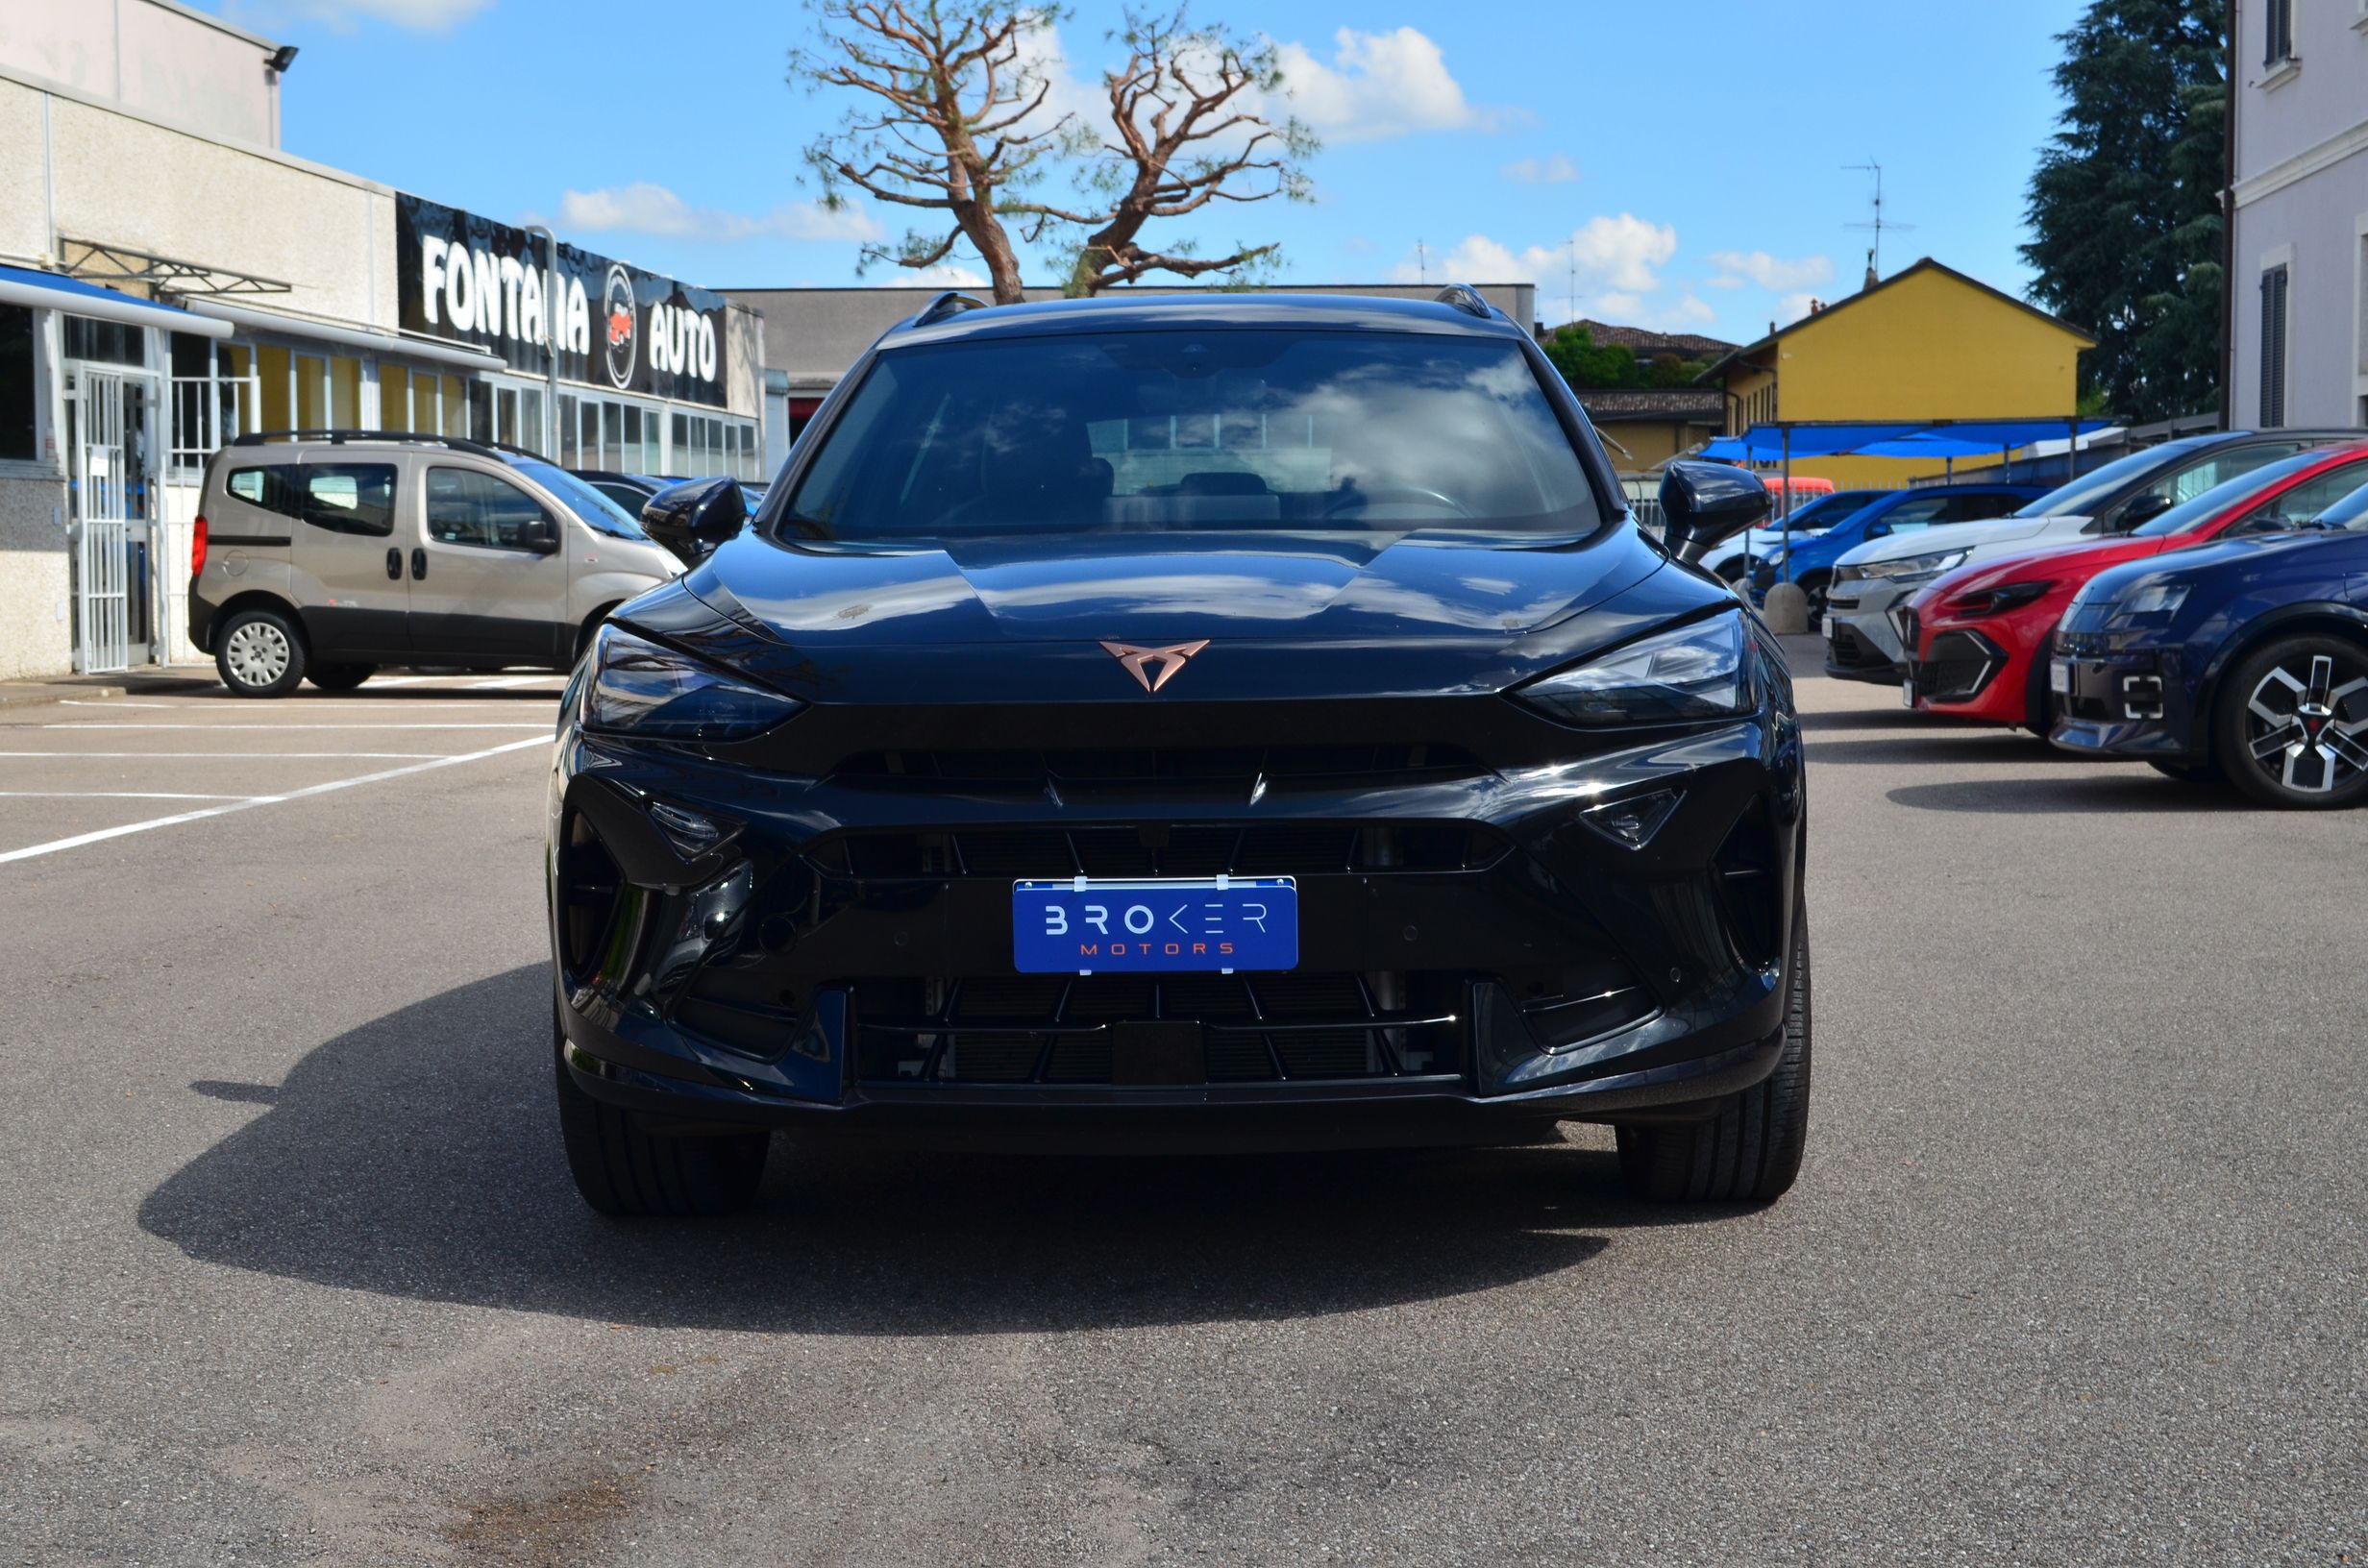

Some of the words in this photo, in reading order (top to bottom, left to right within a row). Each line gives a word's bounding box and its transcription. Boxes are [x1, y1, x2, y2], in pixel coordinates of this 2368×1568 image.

[649, 301, 717, 382] AUTO
[1046, 903, 1267, 935] BROKER
[1080, 943, 1233, 955] MOTORS
